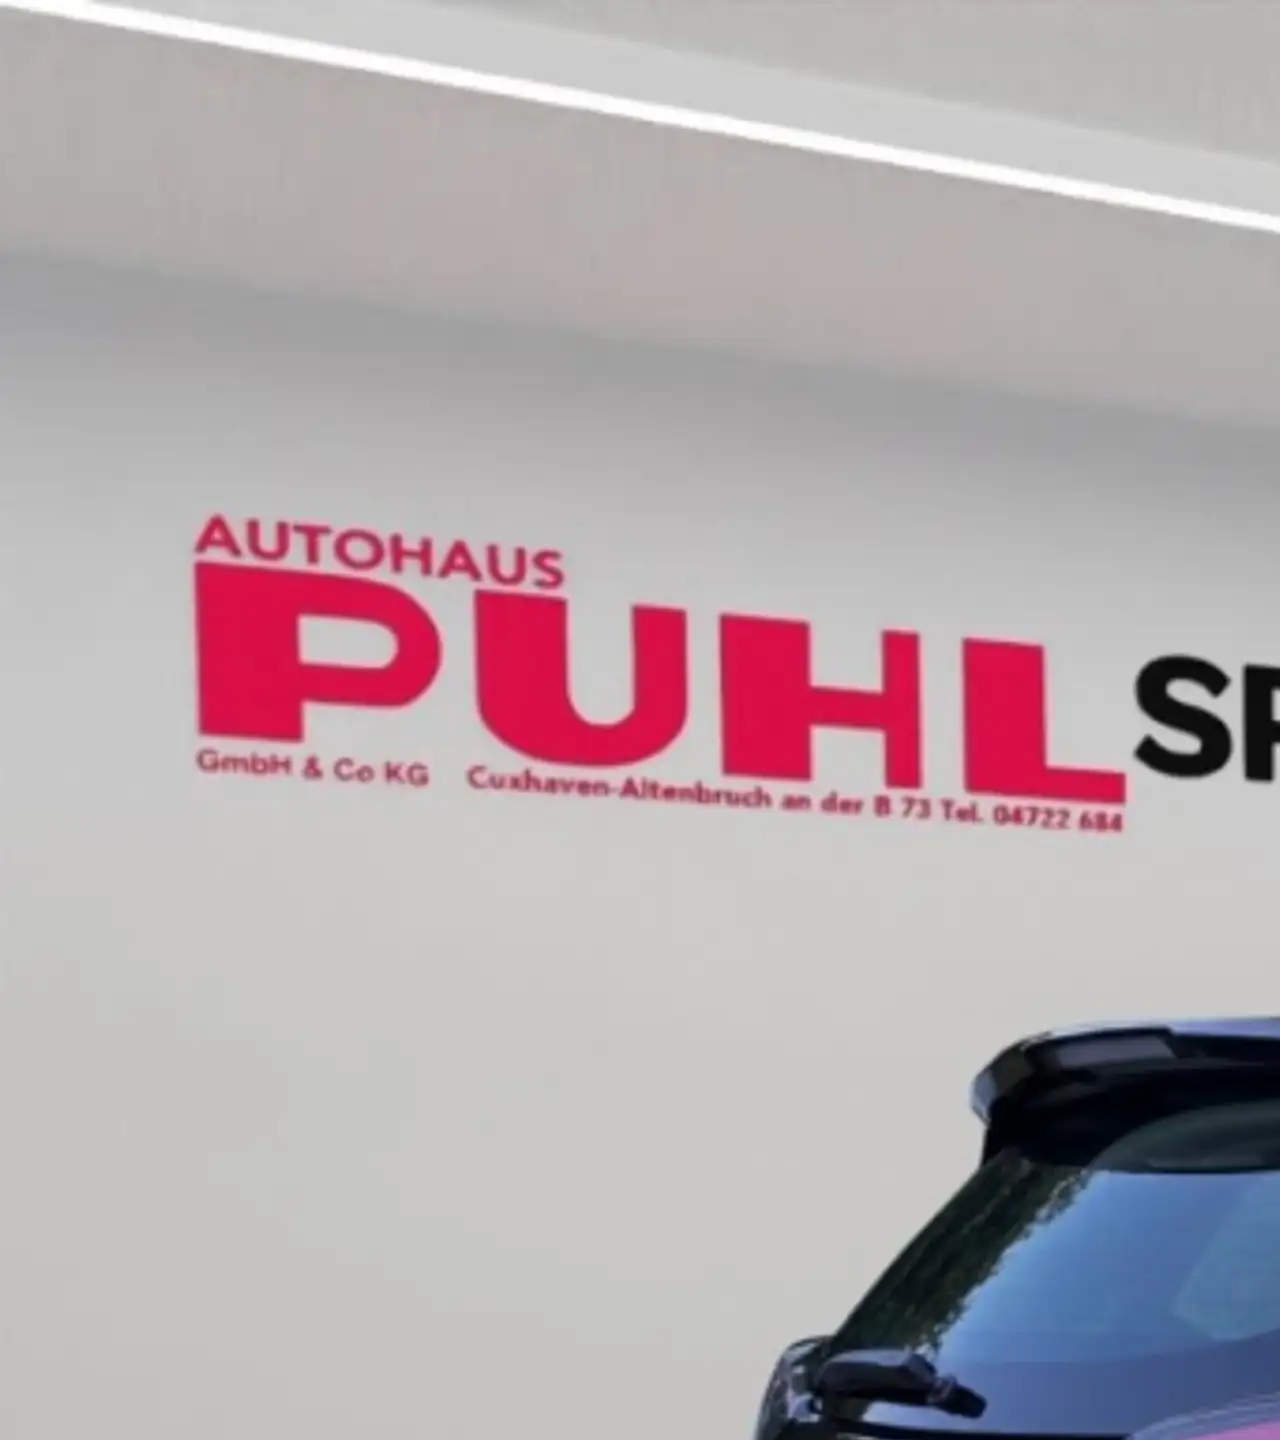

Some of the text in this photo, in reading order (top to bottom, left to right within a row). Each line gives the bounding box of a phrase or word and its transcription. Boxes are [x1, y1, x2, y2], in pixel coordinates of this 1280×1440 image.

[194, 513, 565, 589] AUTOHAUS
[194, 560, 1127, 804] PUHL
[196, 748, 292, 777] GmbH
[303, 755, 324, 780] &
[333, 757, 375, 783] Co
[384, 761, 430, 787] KG
[466, 764, 775, 809] Cuxhaven-Altenbruch
[780, 791, 812, 811] an
[821, 791, 864, 815] der
[873, 795, 891, 817] B
[901, 797, 932, 820] 73
[992, 805, 1071, 830] 04722
[1079, 809, 1124, 834] 684
